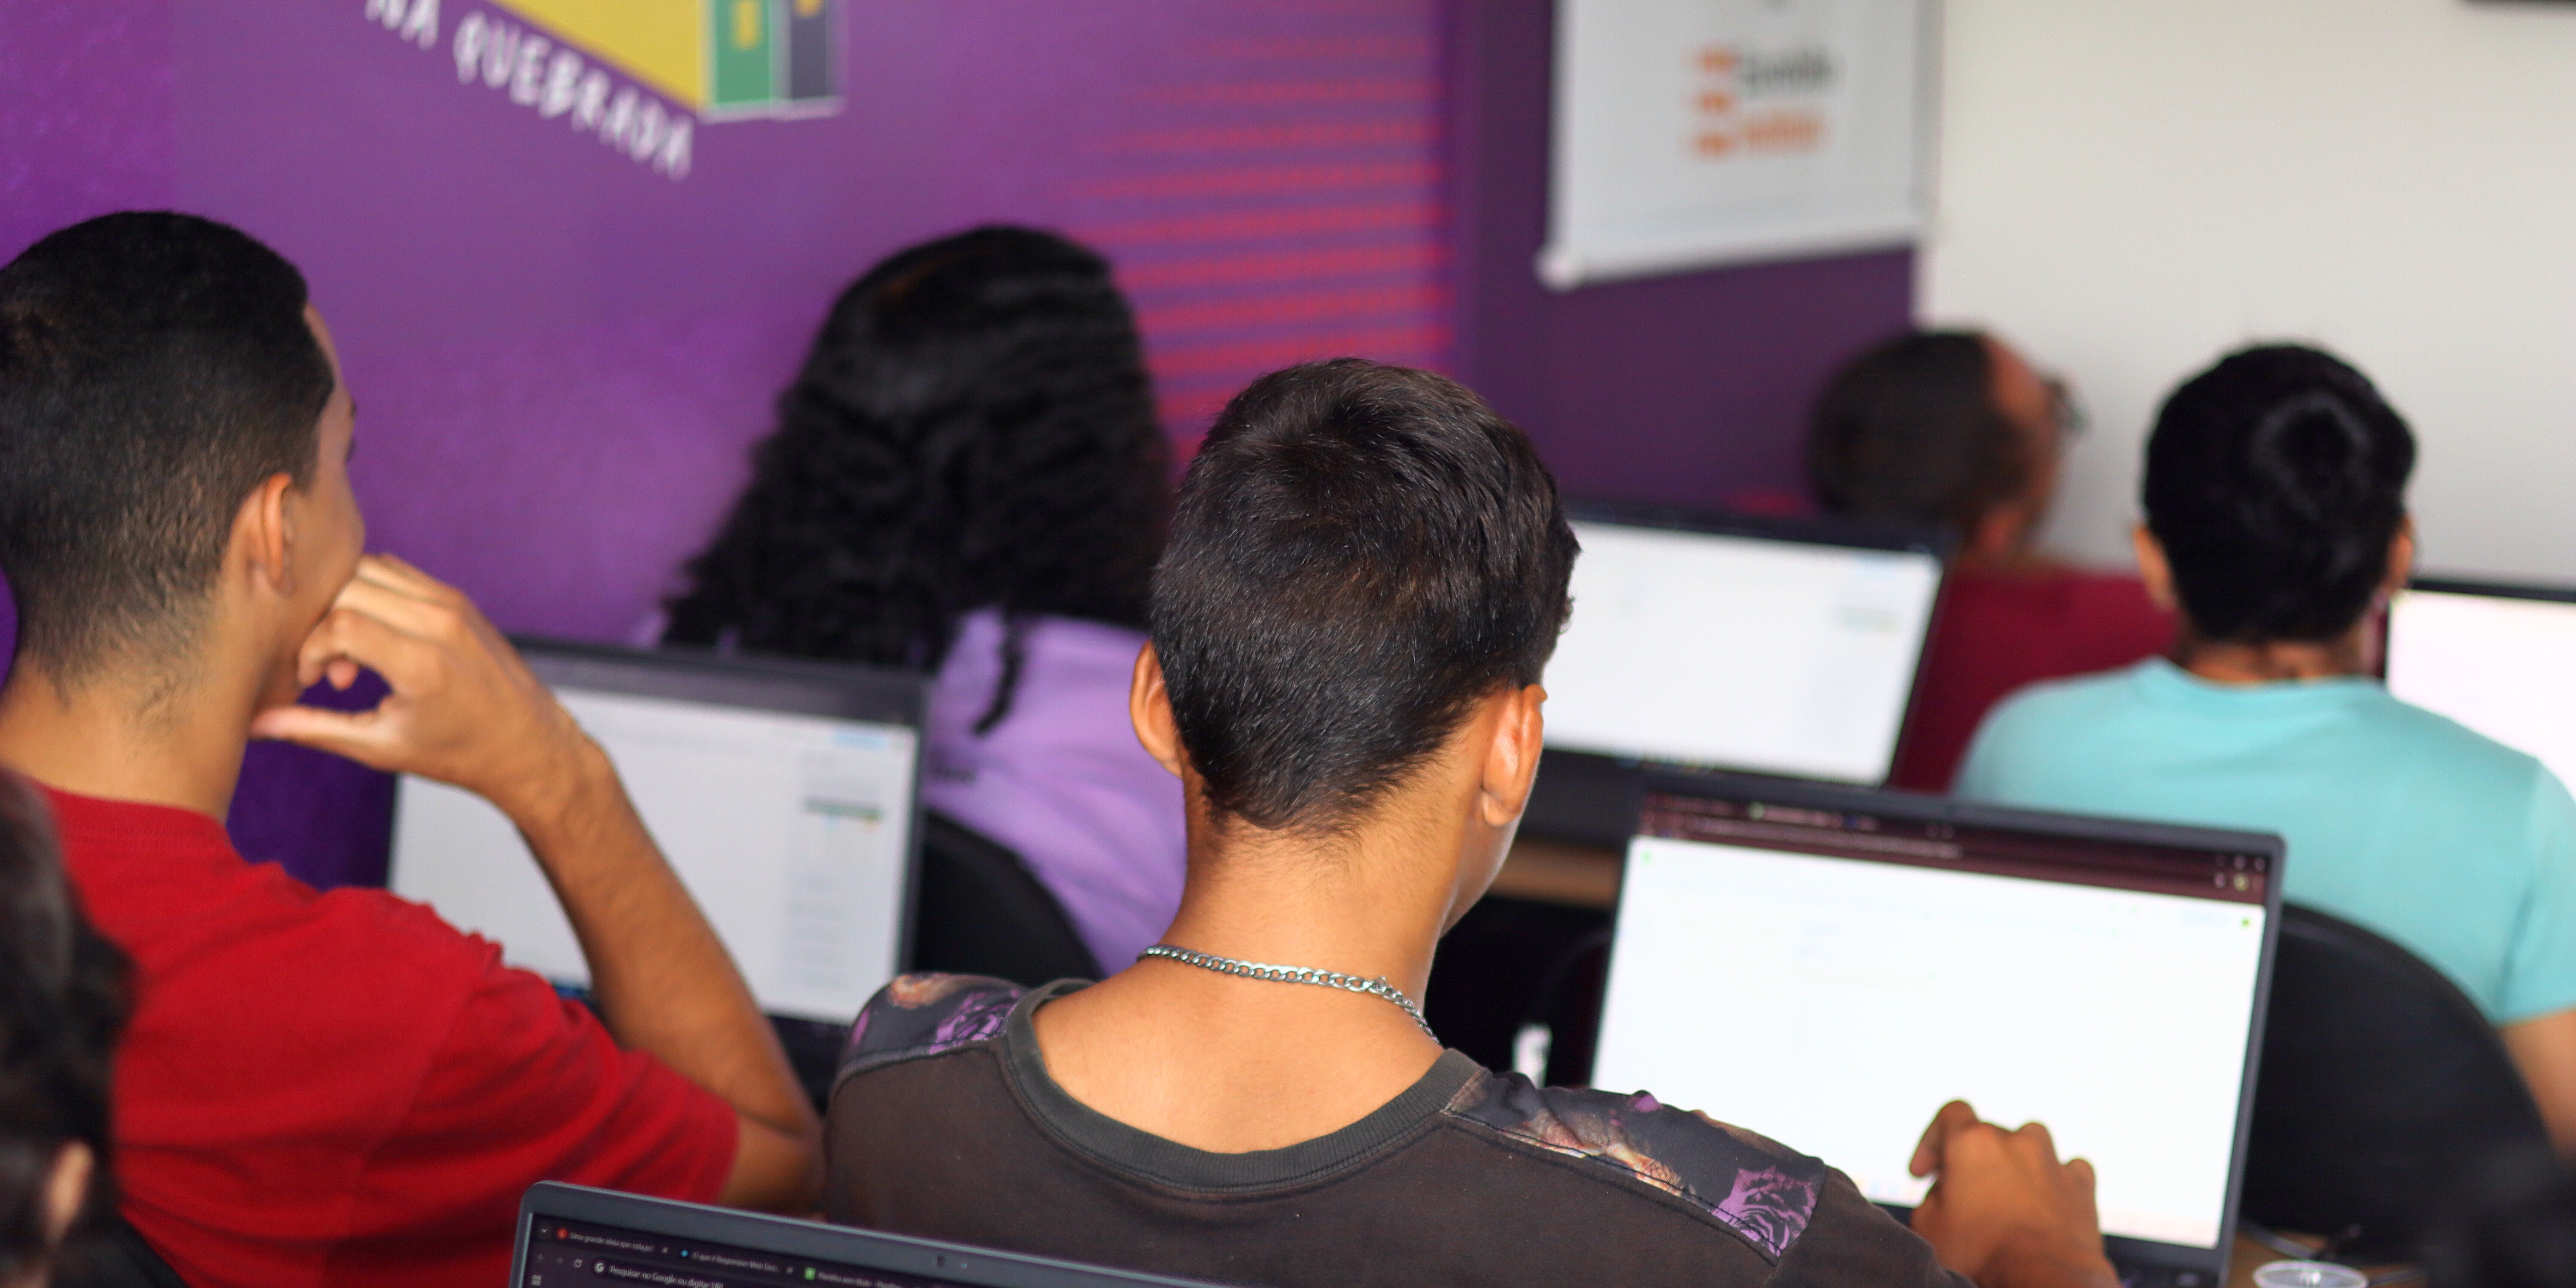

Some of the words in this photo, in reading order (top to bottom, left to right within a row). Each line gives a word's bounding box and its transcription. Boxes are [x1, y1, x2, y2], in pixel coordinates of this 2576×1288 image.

[453, 9, 694, 180] QUEBRADA
[571, 1232, 584, 1241] Uma
[693, 1251, 699, 1259] O
[749, 1260, 763, 1270] Web
[610, 1265, 641, 1277] Pesquisar
[653, 1272, 677, 1285] Google
[688, 1278, 709, 1288] digitar
